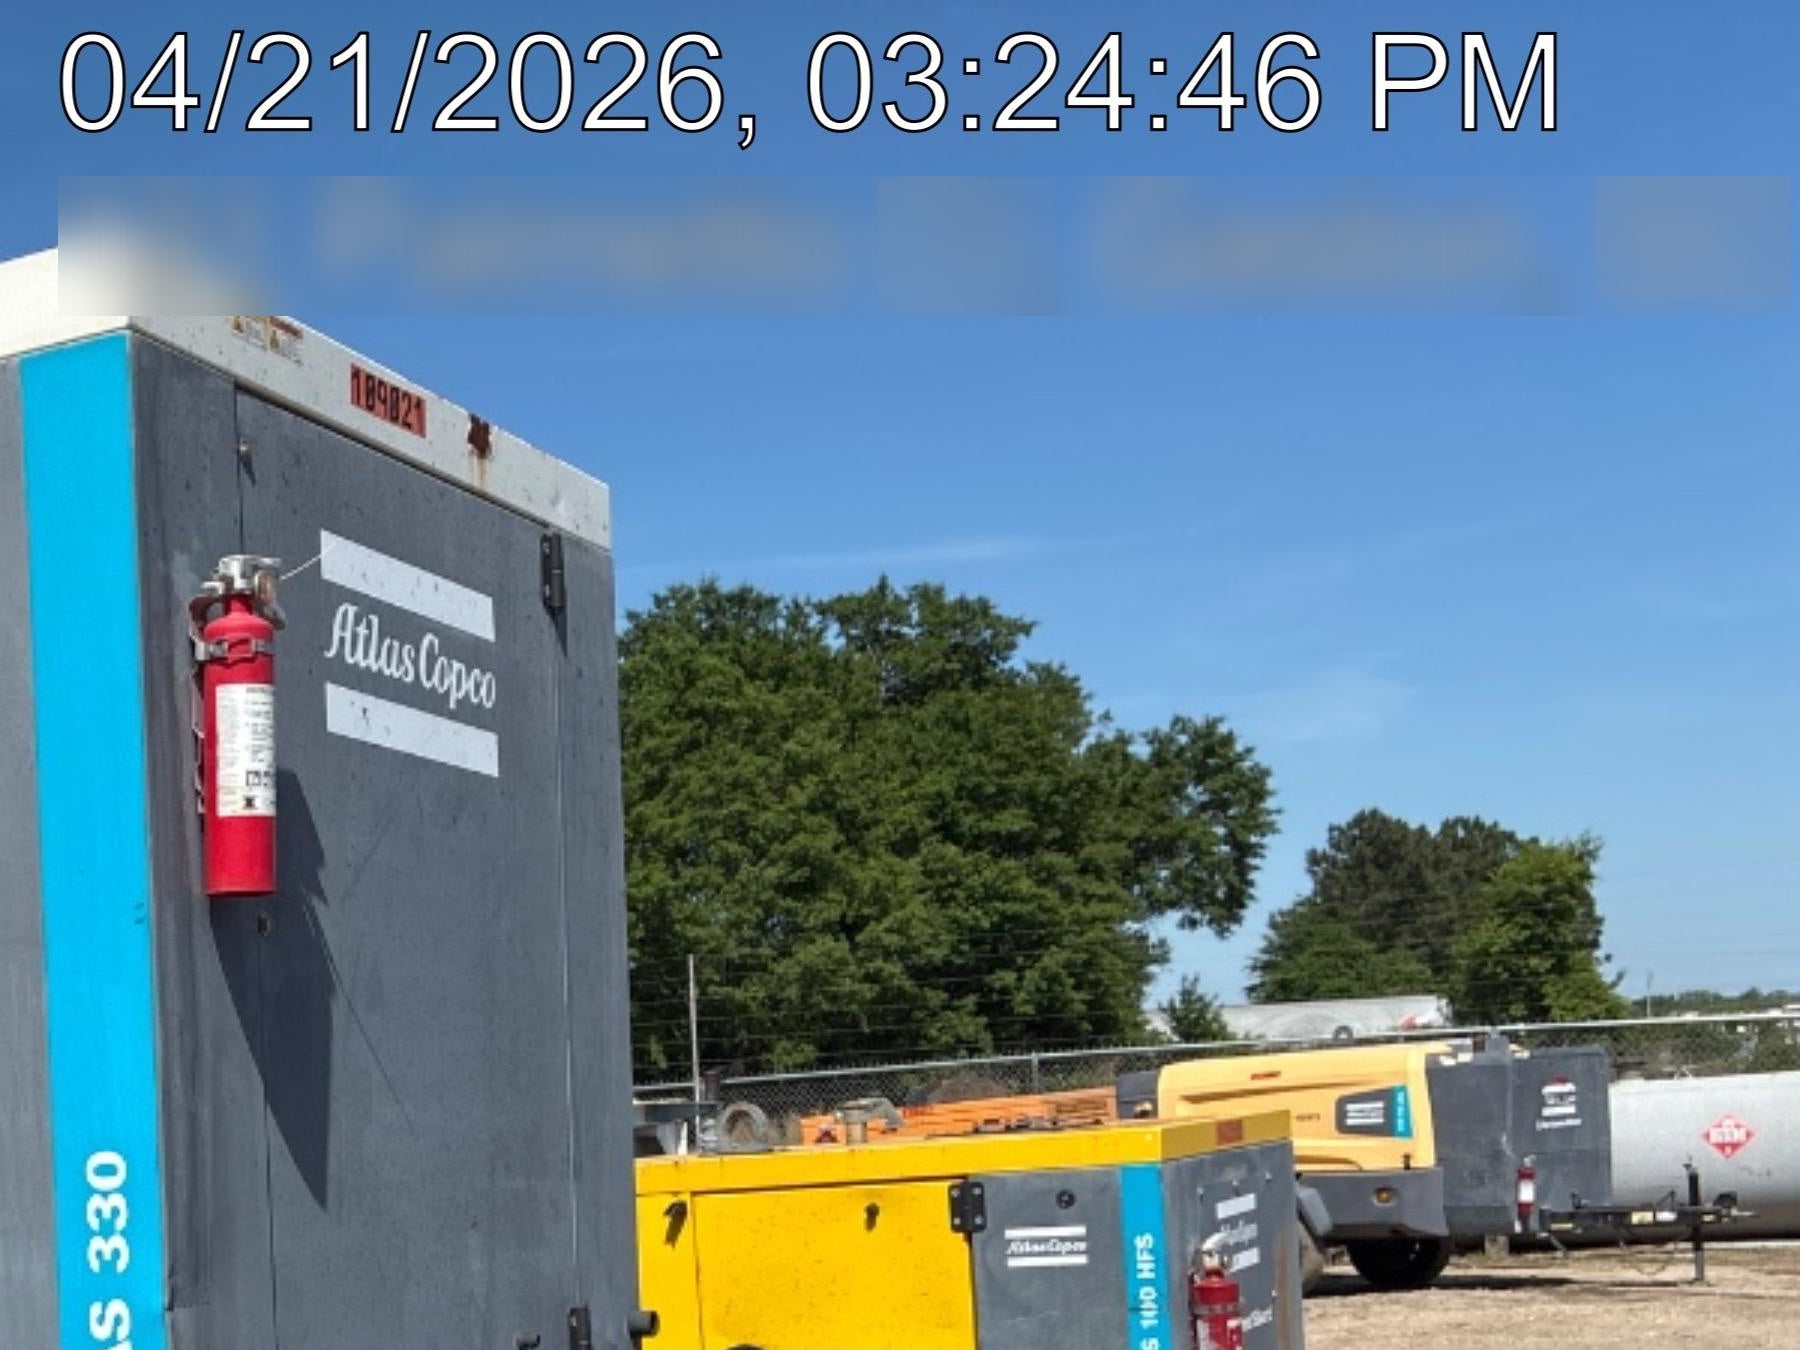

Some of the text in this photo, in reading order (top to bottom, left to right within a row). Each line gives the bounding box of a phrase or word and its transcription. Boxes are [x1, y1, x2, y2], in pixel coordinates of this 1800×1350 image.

[323, 602, 496, 709] Atlas Copco
[85, 1150, 131, 1274] 330
[1134, 1232, 1156, 1279] HFS
